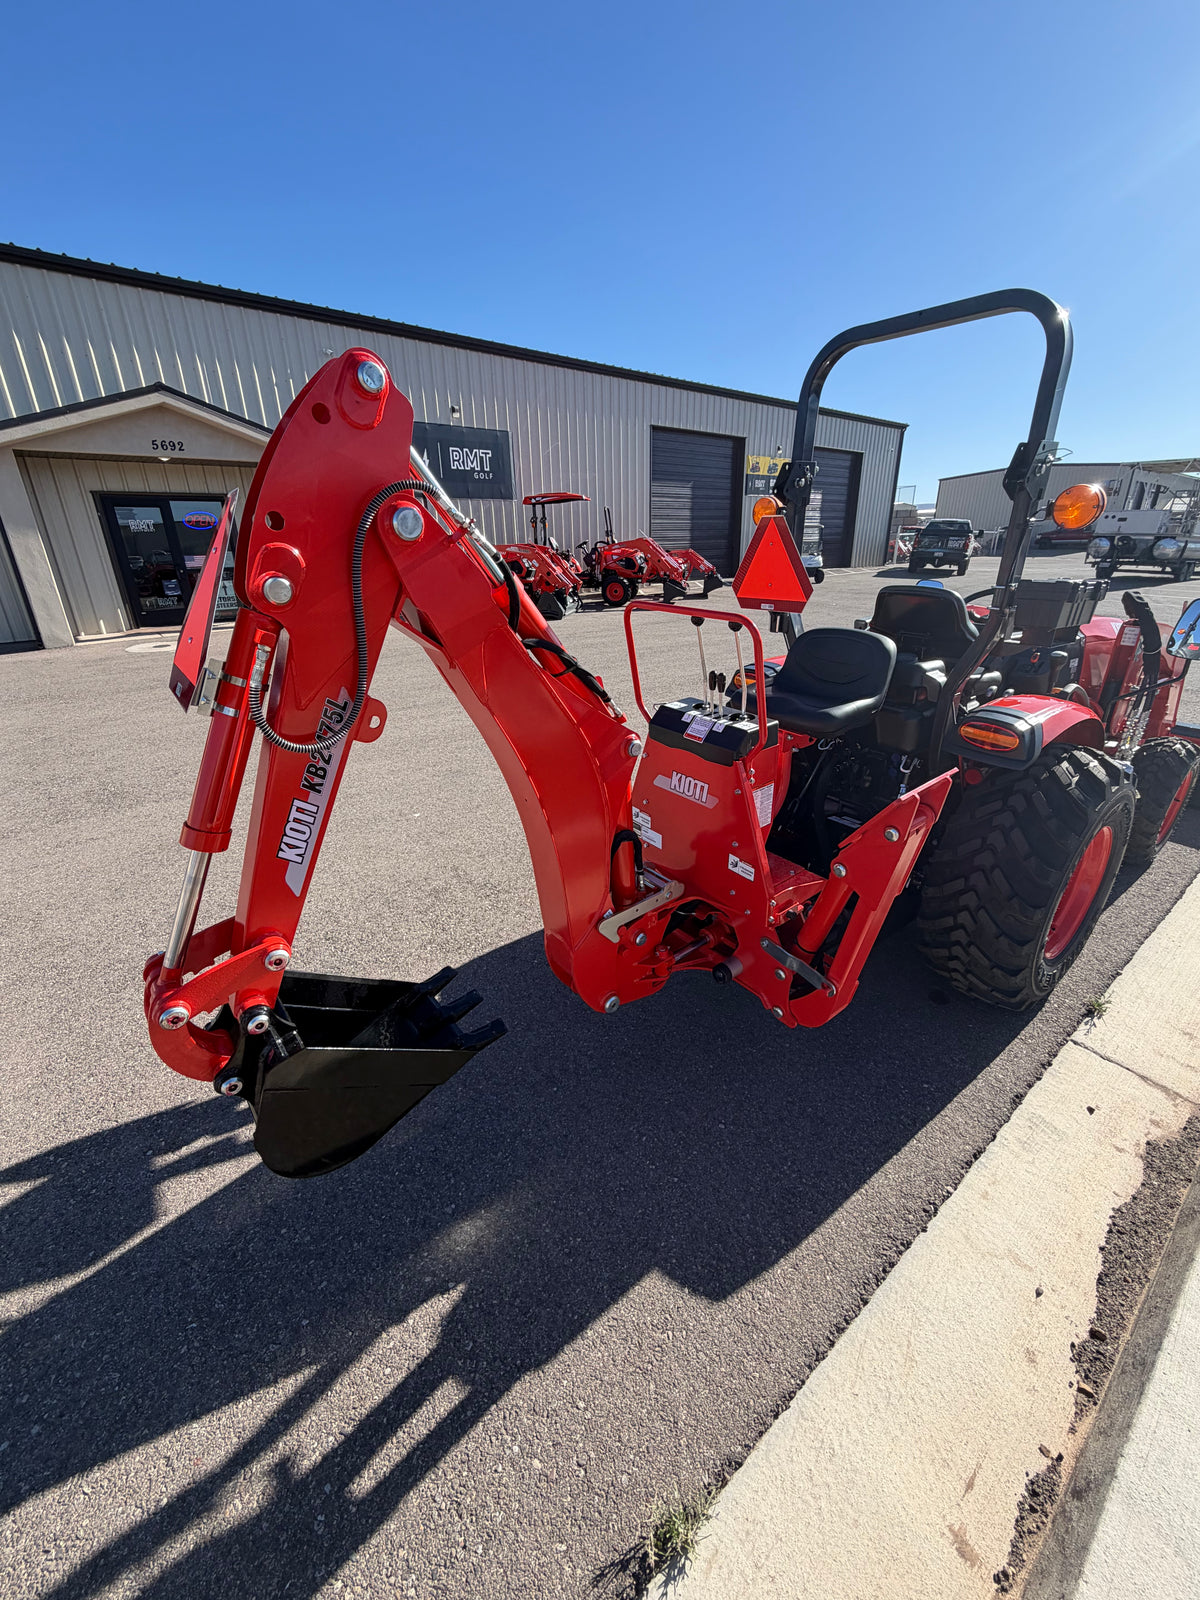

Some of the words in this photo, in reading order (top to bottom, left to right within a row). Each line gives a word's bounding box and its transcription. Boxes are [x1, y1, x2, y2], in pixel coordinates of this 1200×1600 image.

[151, 439, 185, 451] 5692
[449, 446, 492, 471] RMT
[473, 472, 494, 480] GOLF
[128, 519, 154, 530] RMT
[185, 515, 214, 526] OPEN
[217, 595, 236, 603] TORS
[670, 769, 710, 804] KIOTI
[276, 797, 320, 865] KIOTI
